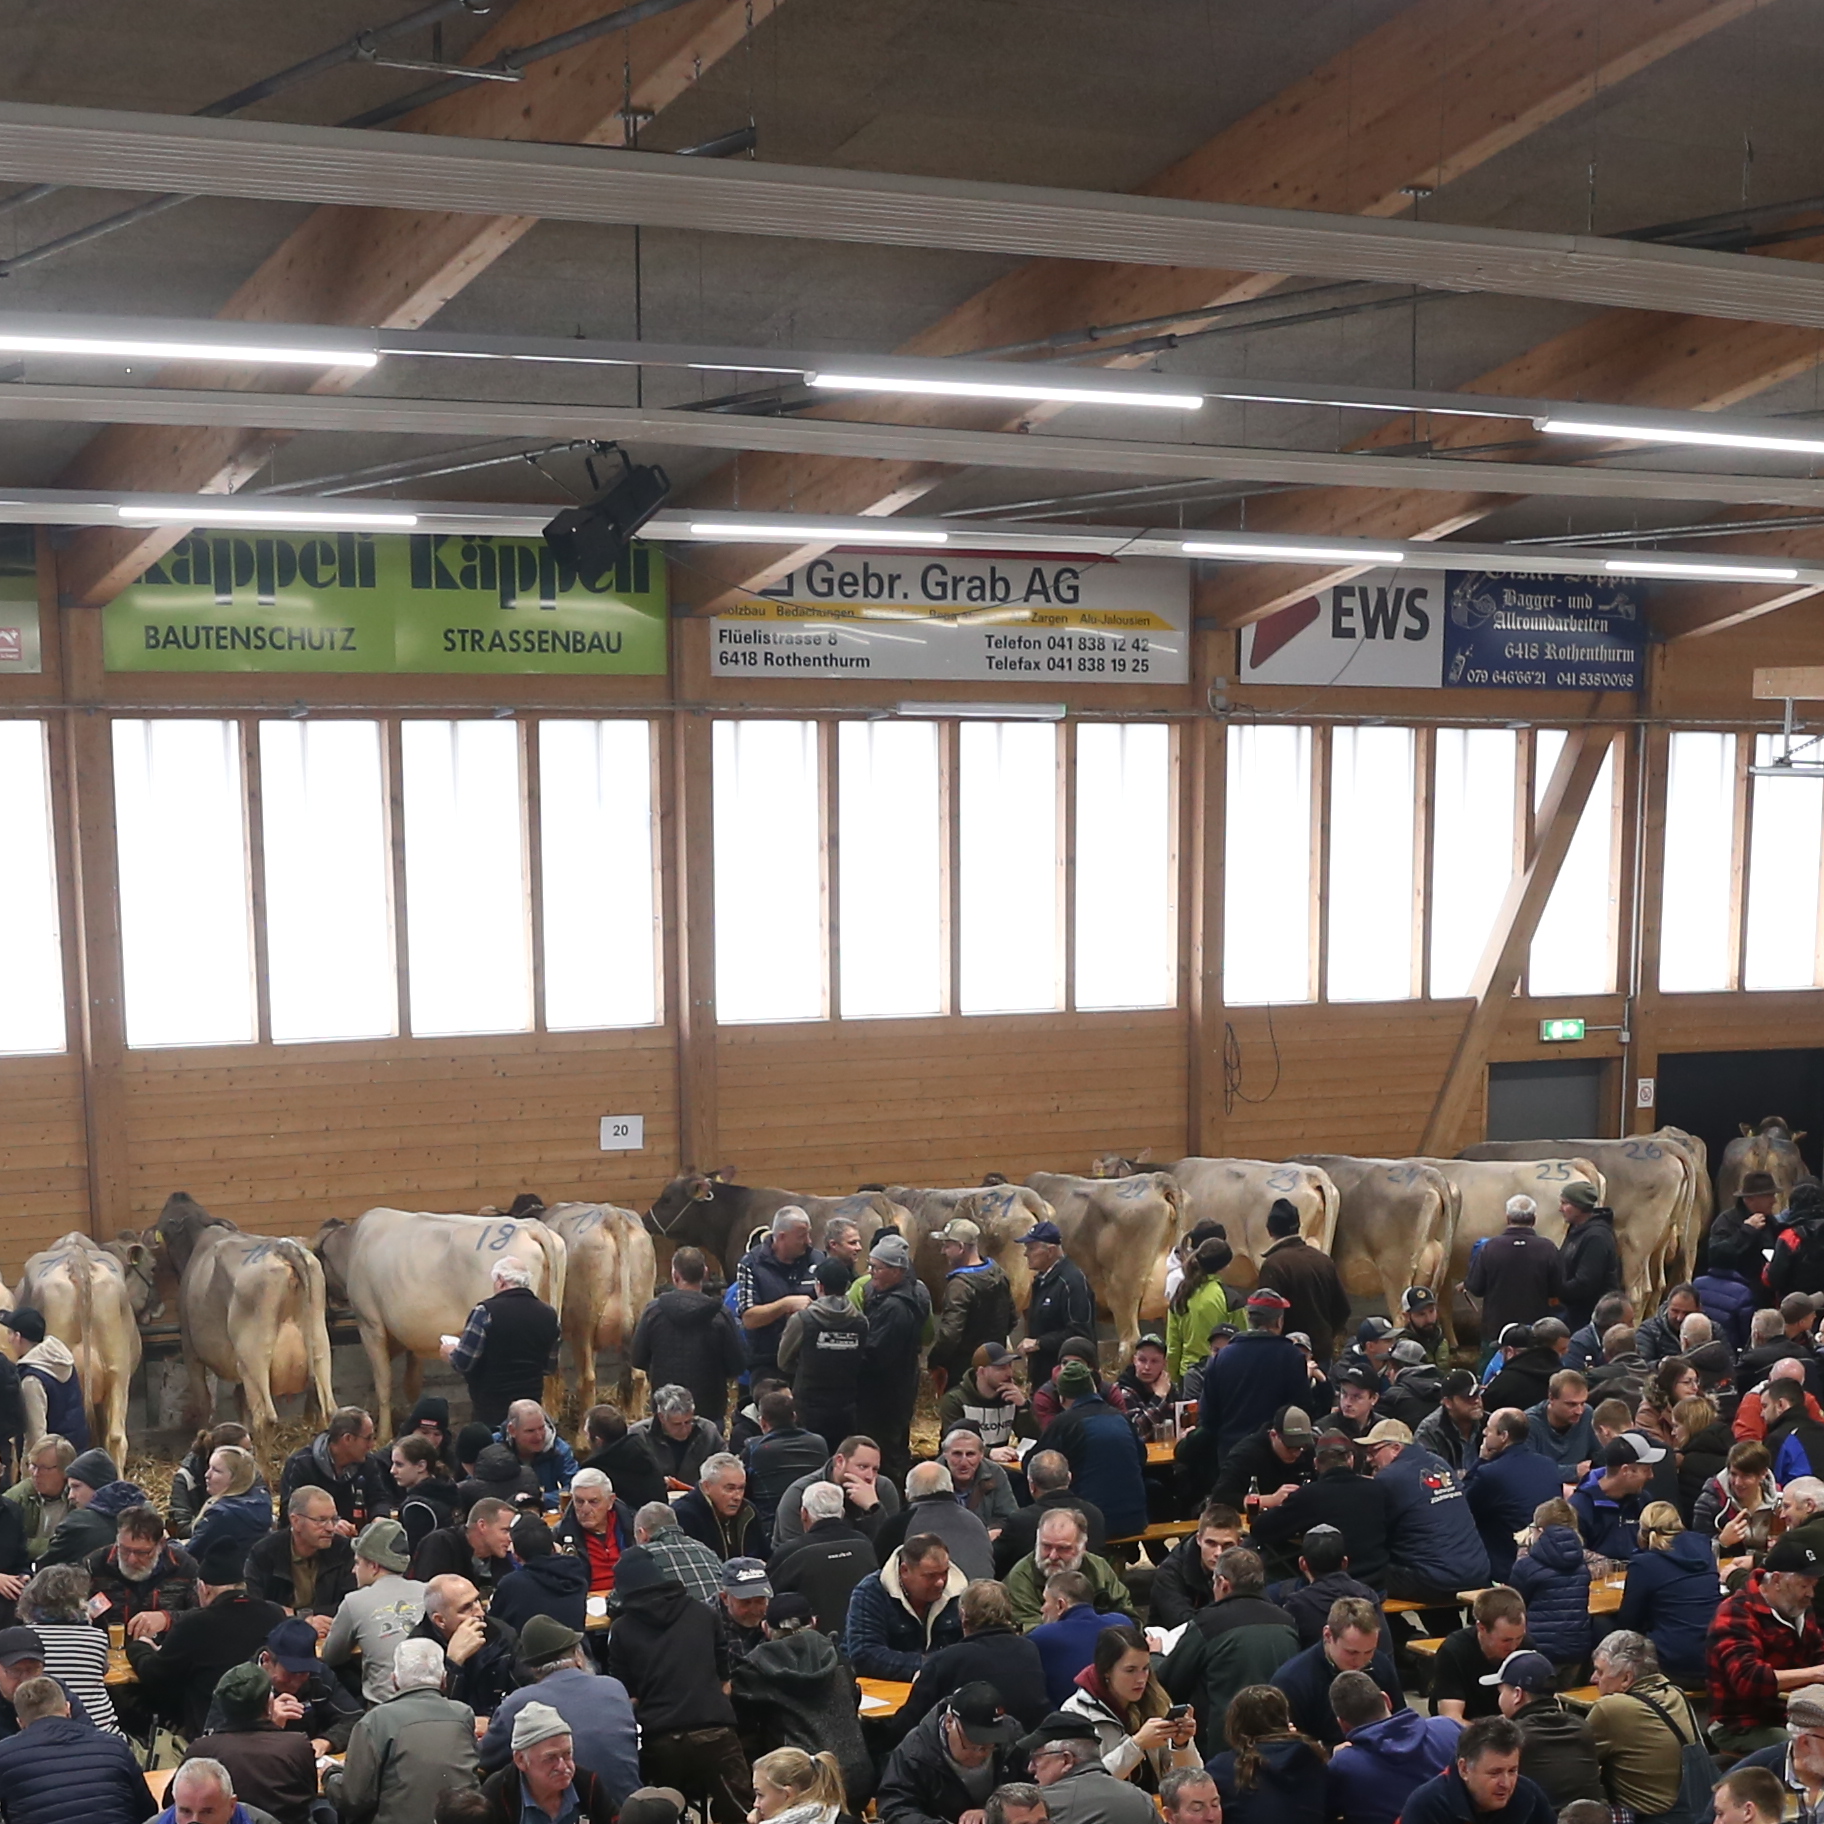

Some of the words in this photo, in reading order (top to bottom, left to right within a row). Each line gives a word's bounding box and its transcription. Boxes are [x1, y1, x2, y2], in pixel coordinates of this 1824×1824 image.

[805, 559, 909, 600] Gebr.
[920, 563, 1012, 603] Grab
[1022, 566, 1081, 604] AG
[1502, 588, 1563, 612] Bagger-
[1567, 593, 1594, 611] und
[776, 605, 855, 620] Bedachungen
[1080, 613, 1151, 627] Alu-Jalousien
[1331, 584, 1431, 642] EWS
[1492, 610, 1609, 633] Allroundarbeiten
[143, 624, 357, 651] BAUTENSCHUTZ
[443, 627, 623, 654] STRASSENBAU
[718, 628, 823, 646] Flüelistrasse
[827, 632, 838, 646] 8
[984, 634, 1042, 650] Telefon
[1047, 636, 1073, 651] 041
[1078, 637, 1106, 651] 838
[1111, 637, 1126, 652] 12
[1131, 638, 1150, 653] 42
[718, 651, 758, 667] 6418
[763, 652, 871, 669] Rothenthurm
[1504, 641, 1540, 660] 6418
[1543, 641, 1636, 664] Rothenthurm
[985, 655, 1042, 671] Telefax
[1046, 657, 1073, 672] 041
[1077, 658, 1106, 672] 838
[1110, 658, 1127, 673] 19
[1131, 659, 1150, 673] 25
[1466, 669, 1489, 684] 079
[1556, 671, 1576, 686] 041
[612, 1124, 629, 1137] 20
[1622, 1142, 1663, 1160] 26
[473, 1222, 518, 1252] 18
